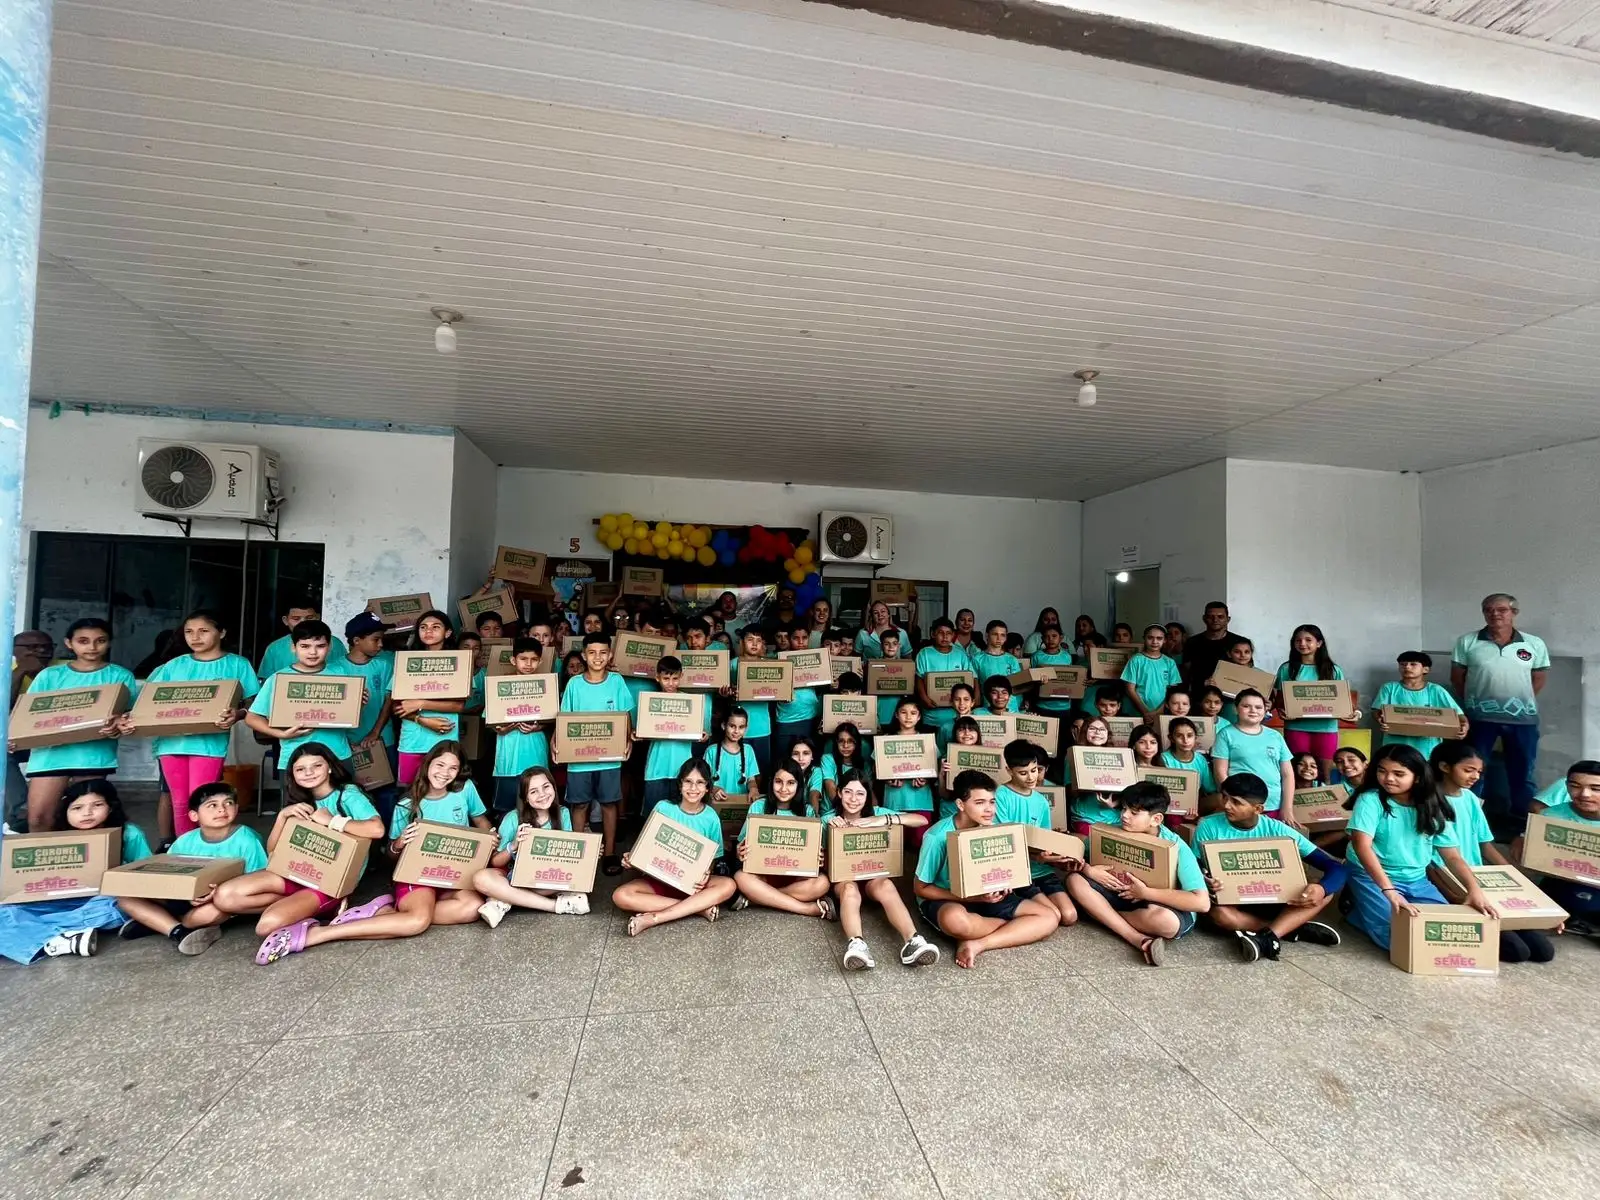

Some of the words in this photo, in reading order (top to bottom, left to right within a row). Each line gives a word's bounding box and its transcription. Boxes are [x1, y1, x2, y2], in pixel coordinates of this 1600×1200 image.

[570, 538, 580, 552] 5
[305, 684, 339, 692] CORONEL
[414, 684, 450, 692] SEMEC
[511, 687, 543, 695] SAPUCAIA
[304, 691, 343, 699] SAPUCAIA
[156, 709, 202, 718] SEMEC
[295, 712, 336, 720] SEMEC
[506, 706, 540, 716] SEMEC
[655, 724, 686, 732] SEMEC
[575, 748, 608, 756] SEMEC
[970, 753, 996, 761] CORONEL
[772, 829, 801, 838] CORONEL
[856, 834, 885, 843] CORONEL
[307, 832, 335, 850] CORONEL
[440, 838, 472, 849] CORONEL
[547, 840, 578, 849] CORONEL
[670, 831, 697, 850] CORONEL
[772, 836, 805, 846] SAPUCAIA
[856, 840, 887, 850] SAPUCAIA
[983, 837, 1008, 848] CORONEL
[35, 847, 78, 857] CORONEL
[304, 840, 336, 859] SAPUCAIA
[437, 845, 473, 858] SAPUCAIA
[546, 847, 581, 858] SAPUCAIA
[667, 838, 698, 860] SAPUCAIA
[983, 845, 1013, 856] SAPUCAIA
[1116, 843, 1147, 858] CORONEL
[34, 854, 83, 866] SAPUCAIA
[1116, 850, 1151, 867] SAPUCAIA
[1236, 852, 1274, 861] CORONEL
[764, 857, 800, 867] SEMEC
[851, 862, 884, 872] SEMEC
[1238, 859, 1280, 869] SAPUCAIA
[288, 861, 323, 880] SEMEC
[652, 856, 685, 879] SEMEC
[421, 867, 462, 879] SEMEC
[535, 870, 572, 881] SEMEC
[981, 869, 1013, 883] SEMEC
[24, 879, 78, 891] SEMEC
[1237, 884, 1281, 895] SEMEC
[1441, 924, 1476, 933] CORONEL
[1441, 932, 1481, 942] SAPUCAIA
[1434, 957, 1477, 966] SEMEC
